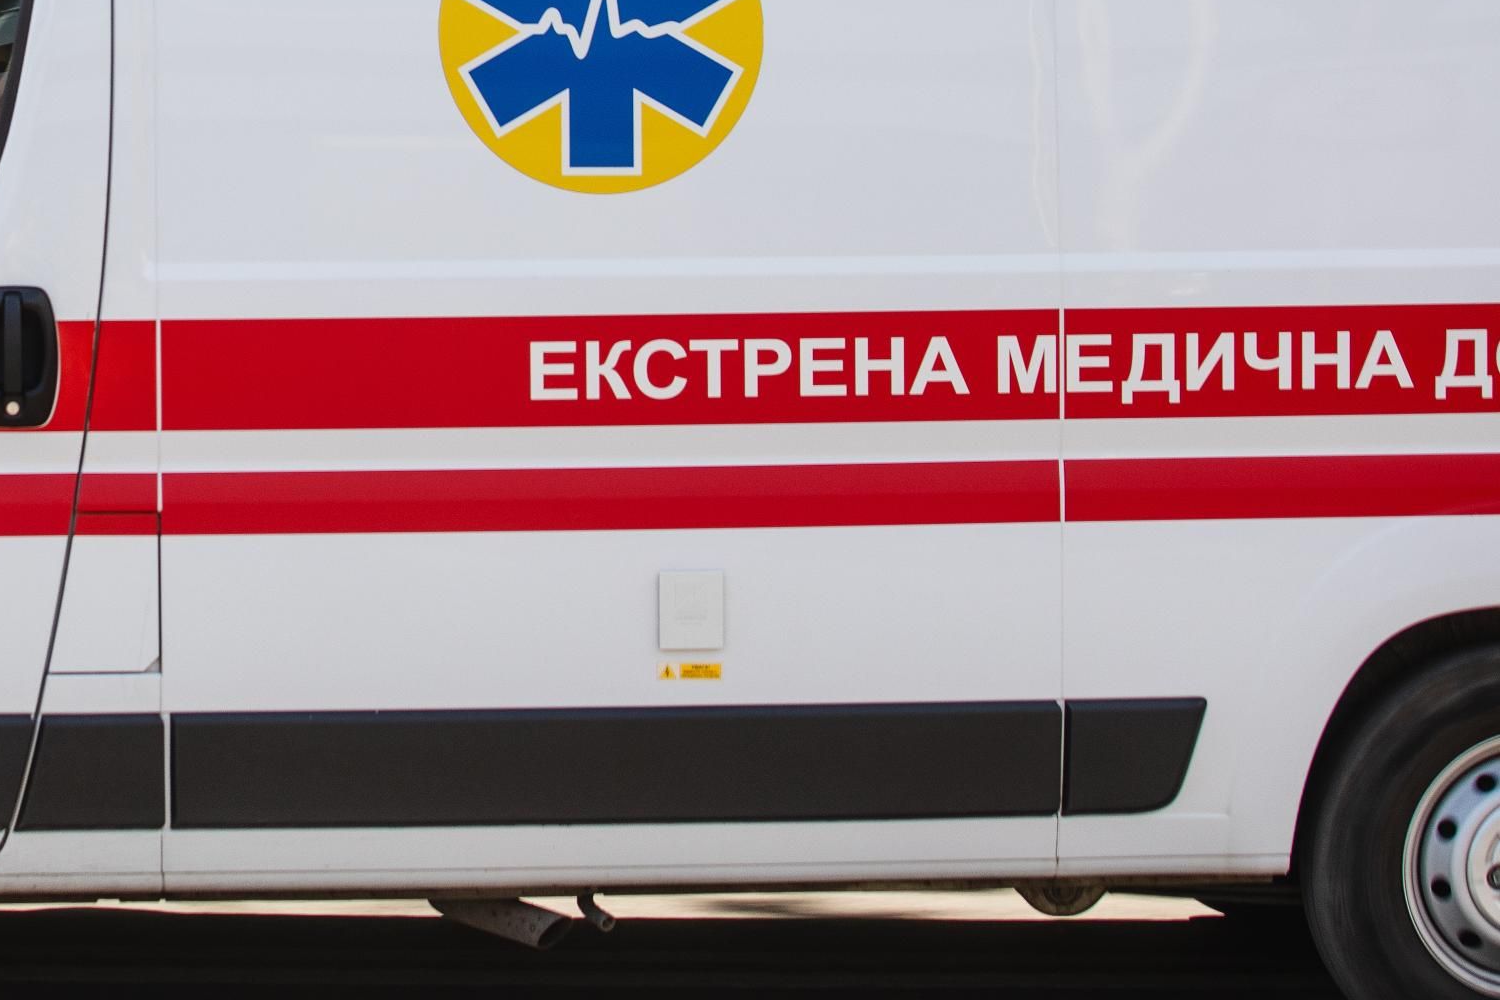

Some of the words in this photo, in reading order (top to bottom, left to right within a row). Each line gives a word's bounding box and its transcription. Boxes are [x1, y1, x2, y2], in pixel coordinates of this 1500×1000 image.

[529, 335, 970, 401] ЕКСТРЕНА
[997, 329, 1415, 405] МЕДИЧНА
[1434, 328, 1500, 401] Д
